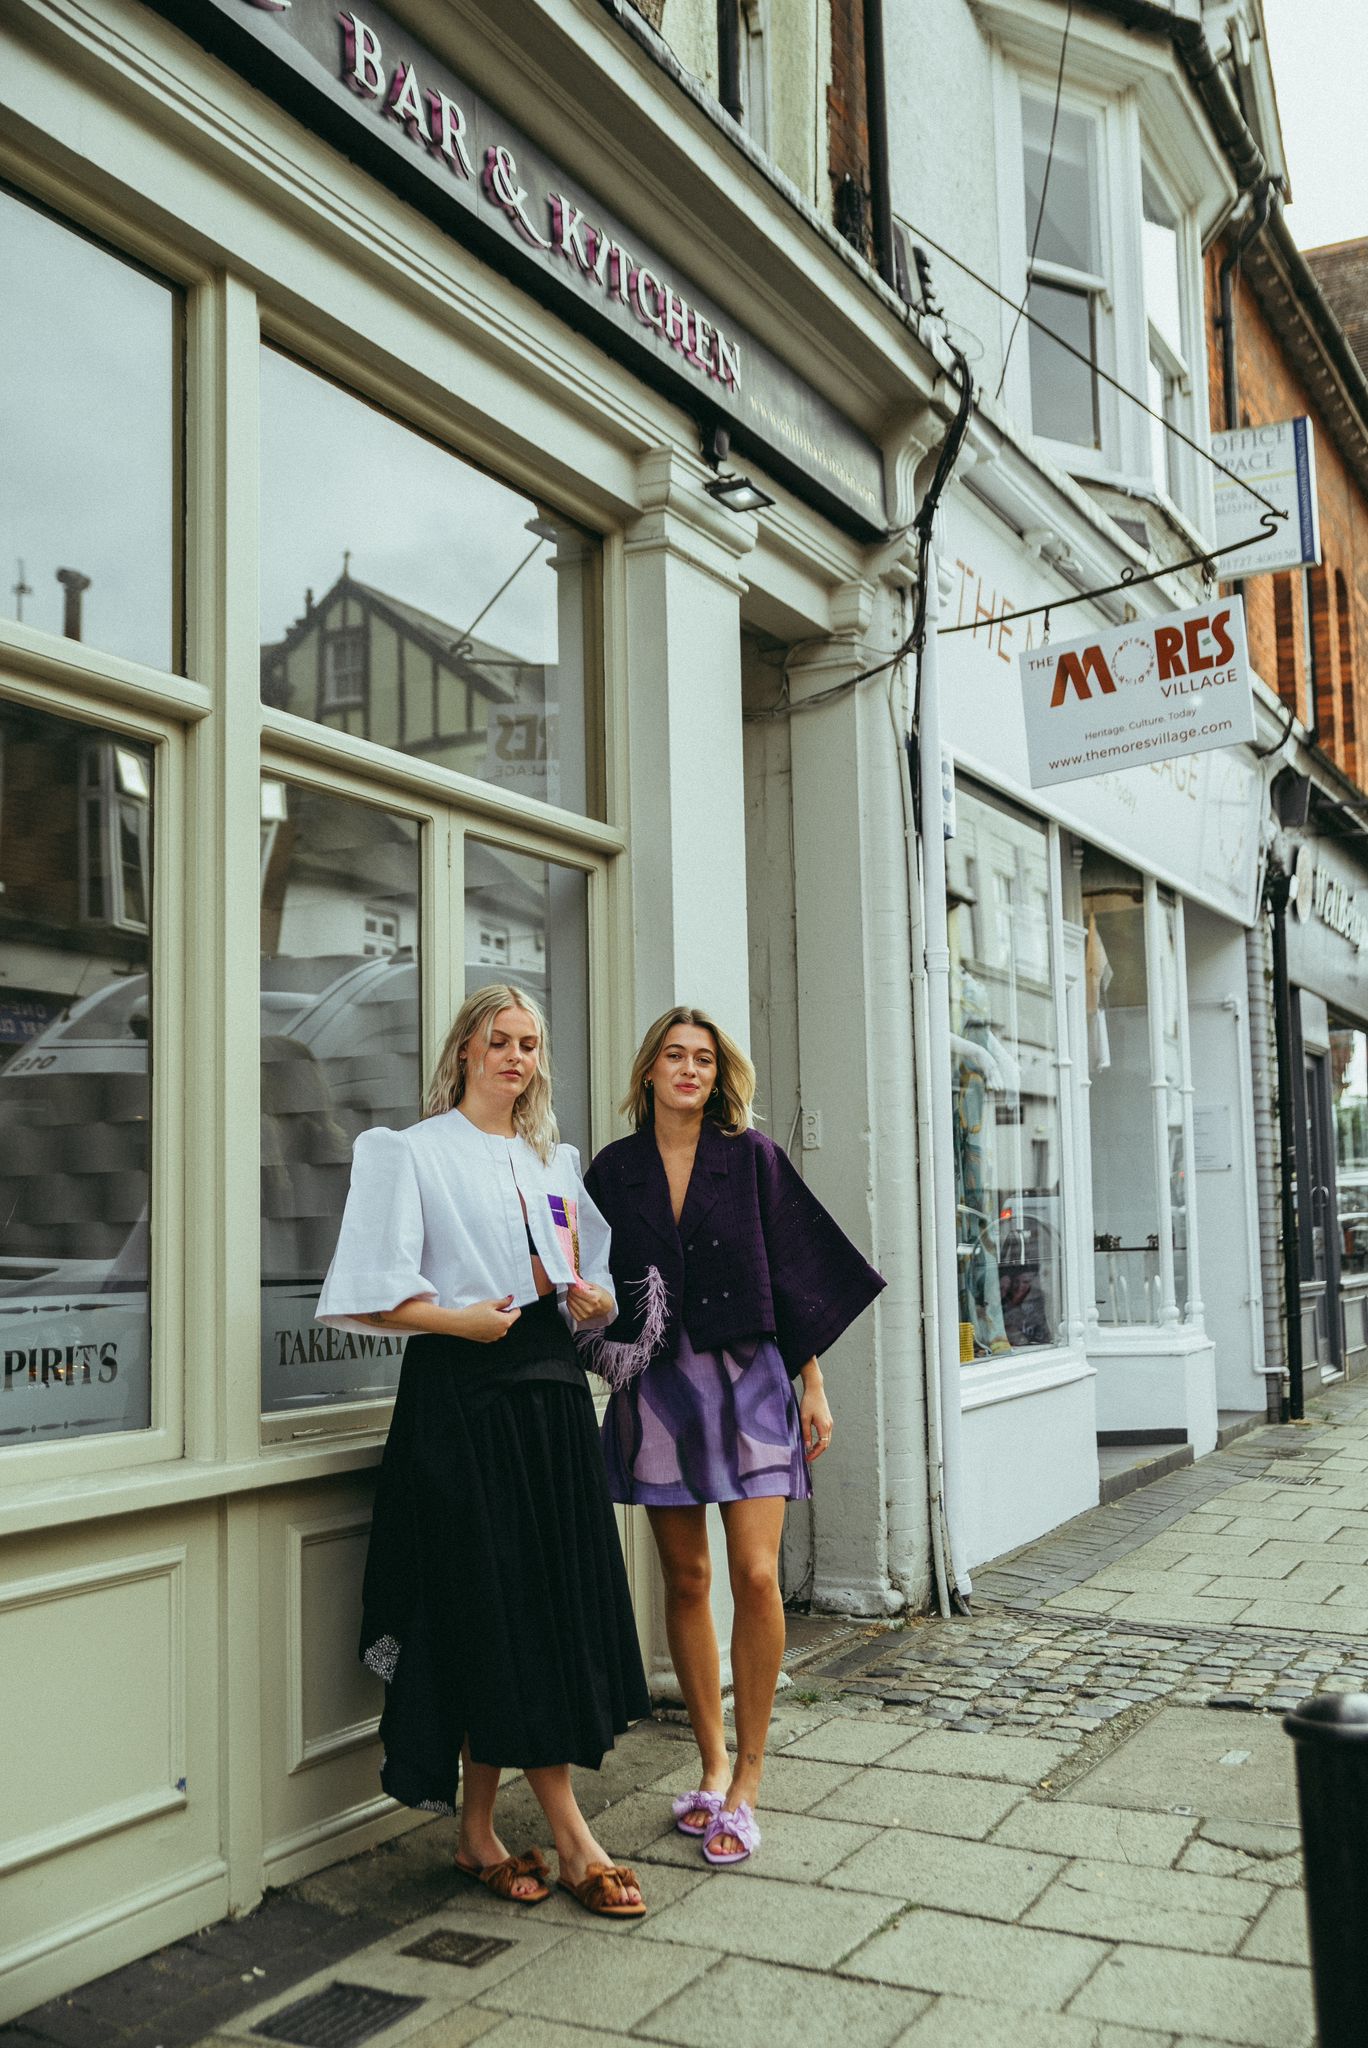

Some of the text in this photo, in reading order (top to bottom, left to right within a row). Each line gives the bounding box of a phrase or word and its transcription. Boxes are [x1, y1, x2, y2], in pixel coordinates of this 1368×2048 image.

[340, 11, 741, 392] BAR & KITCHEN
[1211, 424, 1286, 455] OFFICE
[956, 558, 1015, 664] THE
[1027, 655, 1055, 671] THE
[1050, 609, 1235, 708] MORES
[1161, 668, 1238, 698] VILLAGE
[1168, 707, 1197, 723] Today
[1048, 718, 1233, 770] www.themoresvillage.com
[3, 1342, 118, 1393] PIRITS
